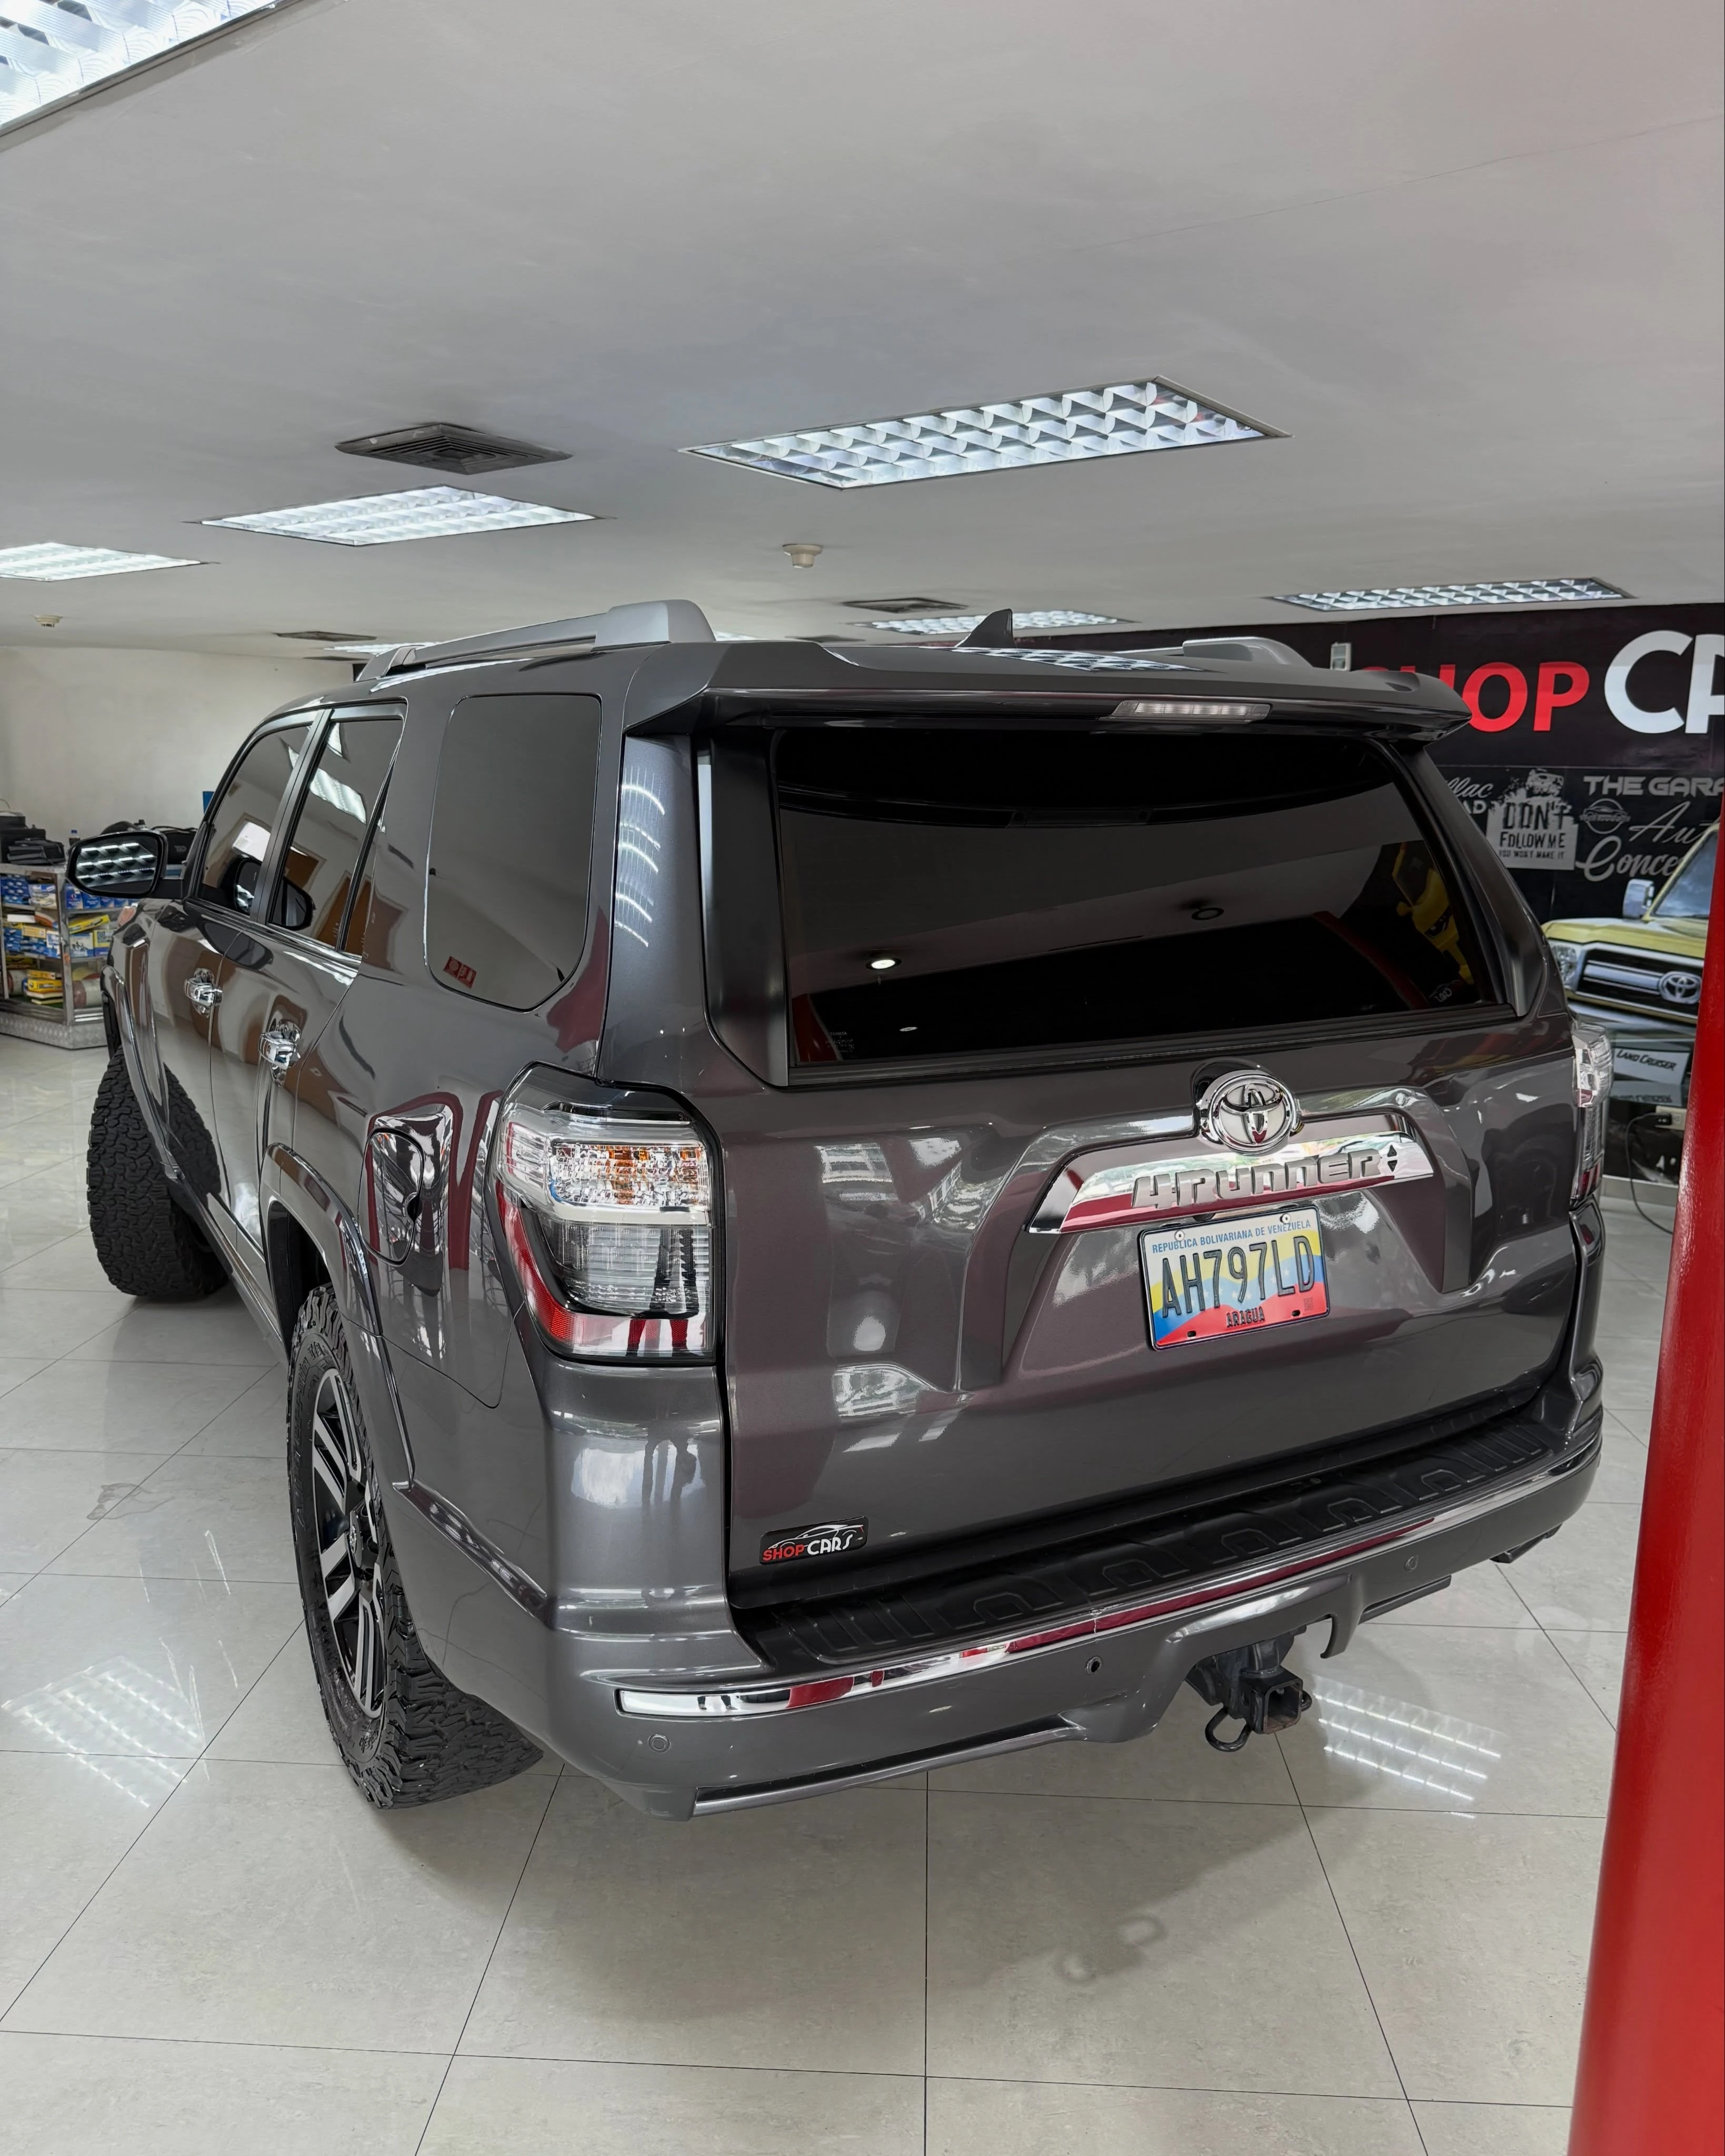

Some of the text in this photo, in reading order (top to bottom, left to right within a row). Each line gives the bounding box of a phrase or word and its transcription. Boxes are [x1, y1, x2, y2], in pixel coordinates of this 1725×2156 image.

[1362, 662, 1589, 732] OP
[1445, 777, 1494, 798] llac
[1583, 775, 1646, 796] THE
[1500, 831, 1567, 849] FOLLOW ME
[1558, 851, 1565, 860] IT
[1576, 835, 1684, 882] Conce
[1639, 1054, 1678, 1071] CRUISER
[1152, 1220, 1311, 1253] REPUBLICA BOLIVARIANA DE VENEZUELA
[1162, 1235, 1315, 1319] AH797LD
[1227, 1306, 1266, 1328] ARAGUA
[763, 1544, 805, 1561] SHOP
